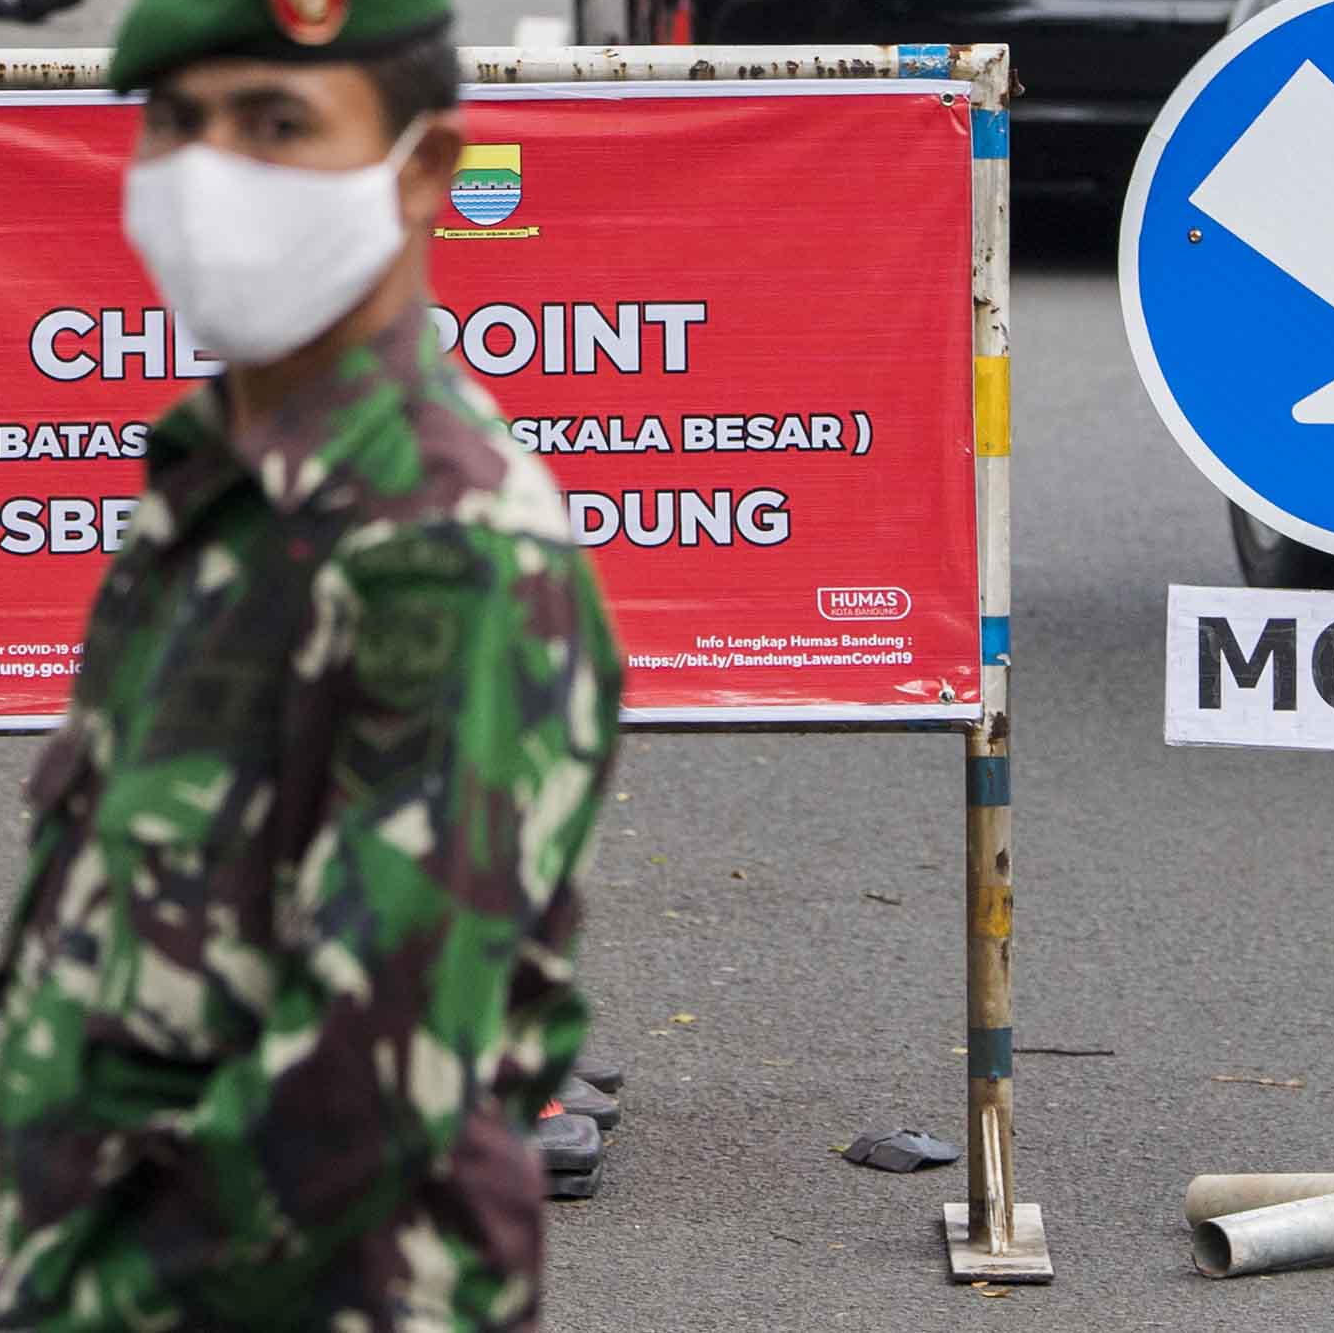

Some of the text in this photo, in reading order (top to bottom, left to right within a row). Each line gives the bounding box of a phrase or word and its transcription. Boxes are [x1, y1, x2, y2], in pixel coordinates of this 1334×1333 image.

[29, 307, 229, 382] CHE
[510, 414, 673, 454] SKALA
[682, 413, 847, 453] BESAR
[568, 488, 791, 547] DUNG
[831, 592, 898, 607] HUMAS
[8, 643, 68, 655] COVID-19
[696, 636, 724, 649] Info
[728, 635, 786, 652] Lengkap
[790, 635, 838, 647] Humas
[842, 634, 904, 651] Bandung
[628, 651, 913, 669] https://bit.ly/BandungLawanCovid19
